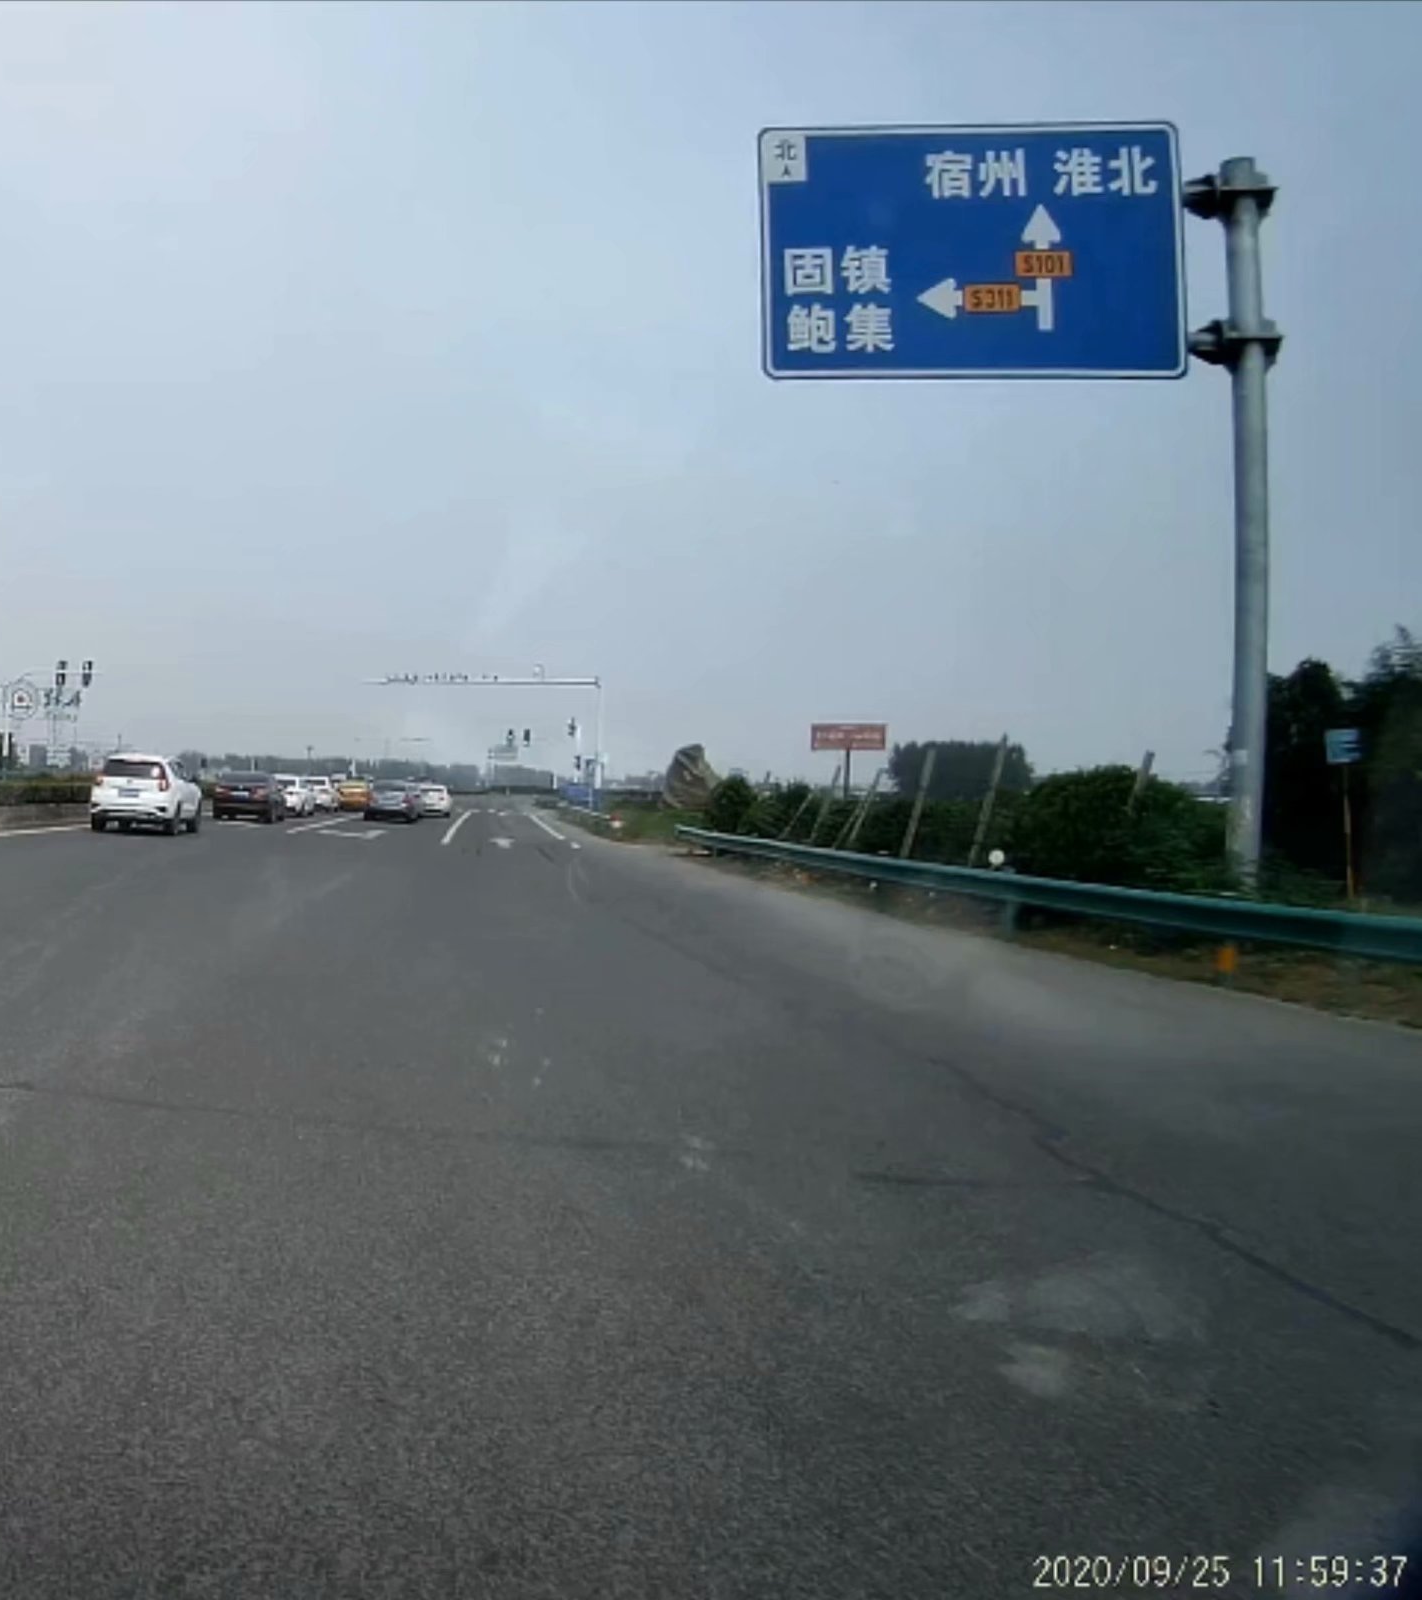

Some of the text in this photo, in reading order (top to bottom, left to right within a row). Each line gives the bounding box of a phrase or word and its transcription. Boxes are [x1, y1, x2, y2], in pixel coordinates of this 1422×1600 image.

[774, 139, 798, 161] 北
[925, 145, 1159, 199] 宿州 淮北
[783, 245, 892, 296] 固镇
[1023, 254, 1065, 275] S101
[971, 286, 1015, 310] S311
[786, 303, 895, 354] 鲍集
